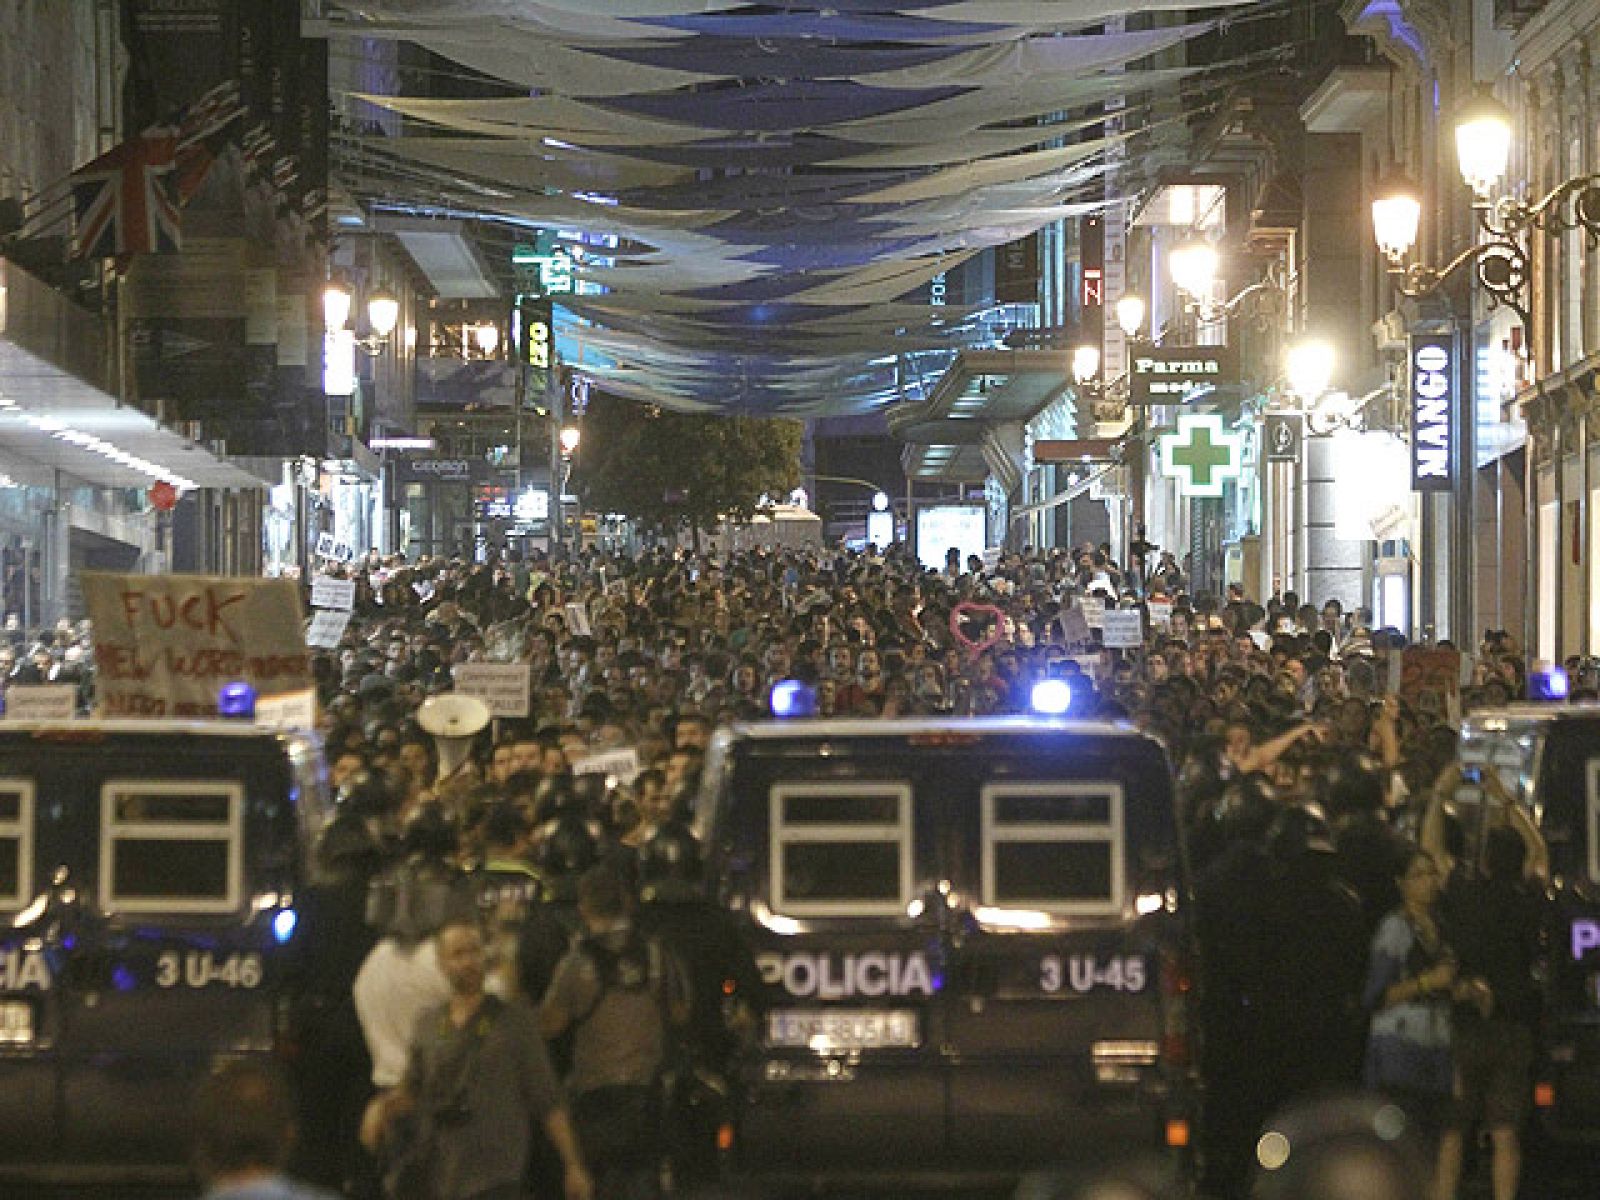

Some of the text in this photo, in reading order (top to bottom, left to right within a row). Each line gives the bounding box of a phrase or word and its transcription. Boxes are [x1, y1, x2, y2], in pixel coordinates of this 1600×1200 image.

[1135, 358, 1218, 373] Parma
[1416, 344, 1448, 477] MANGO
[122, 588, 247, 643] FUCK
[156, 954, 262, 989] 3 U-46
[1040, 954, 1146, 992] 3 U-45
